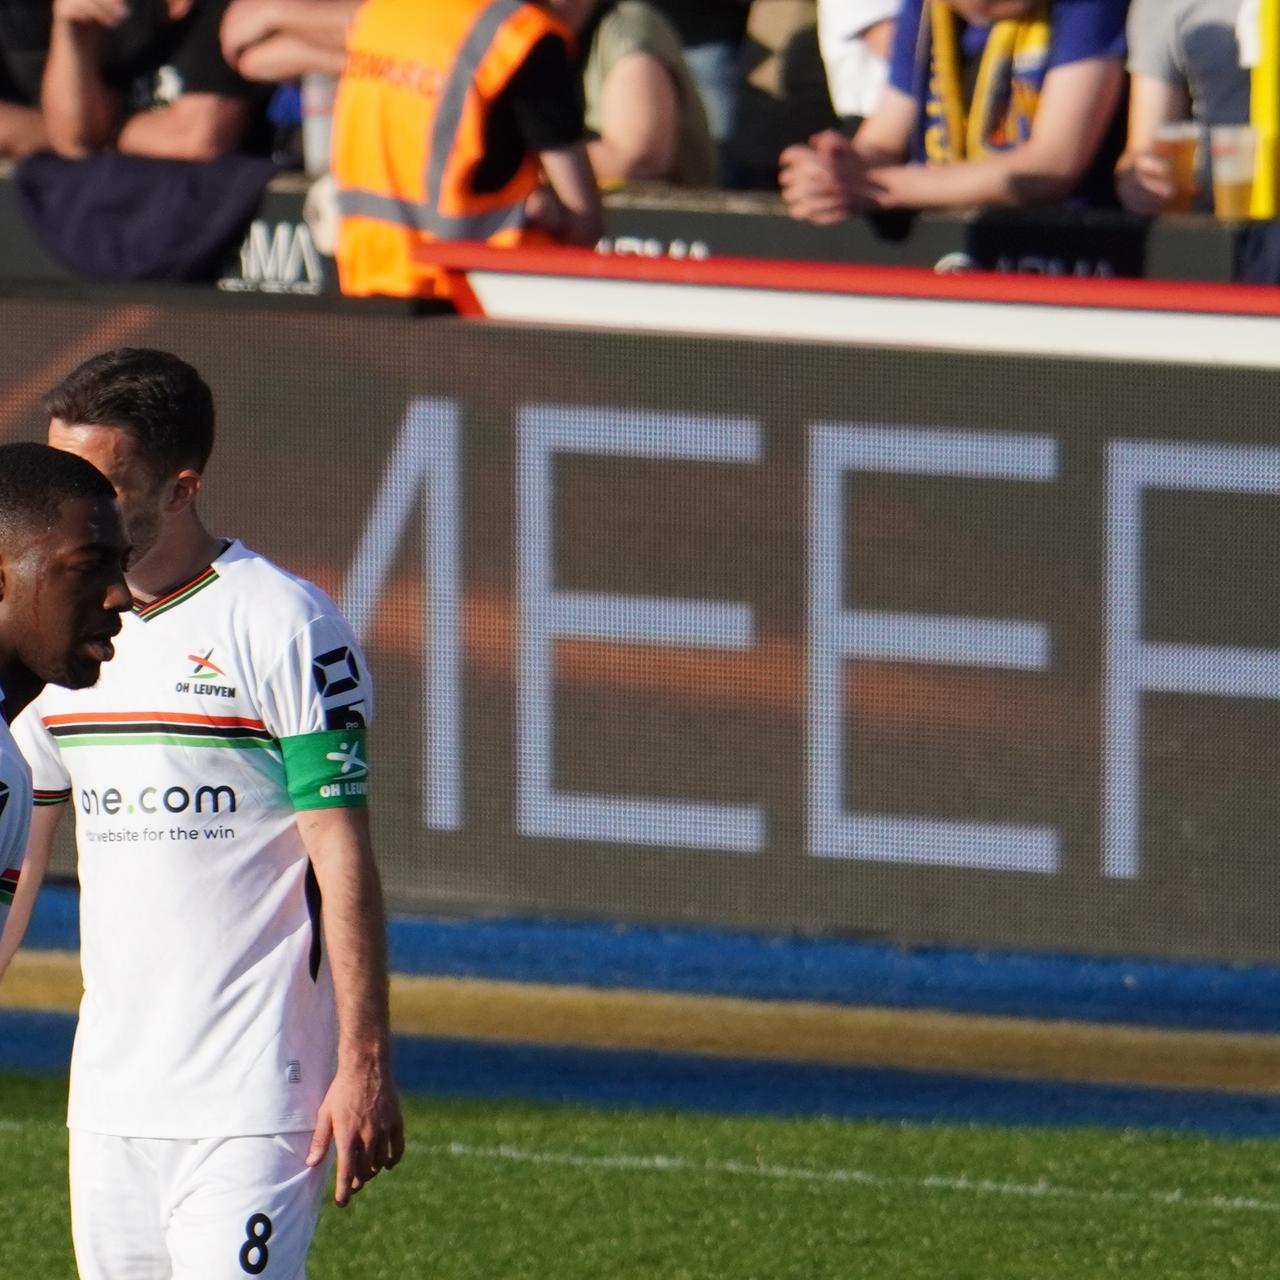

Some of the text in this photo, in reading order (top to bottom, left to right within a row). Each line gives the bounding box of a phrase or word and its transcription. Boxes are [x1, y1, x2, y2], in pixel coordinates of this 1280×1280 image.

[244, 221, 322, 283] MA
[194, 684, 236, 698] LEUVEN
[81, 784, 237, 816] one.com
[320, 783, 341, 798] OH
[143, 828, 164, 841] for
[169, 827, 199, 841] the
[203, 825, 235, 841] win
[239, 1212, 272, 1275] 8
